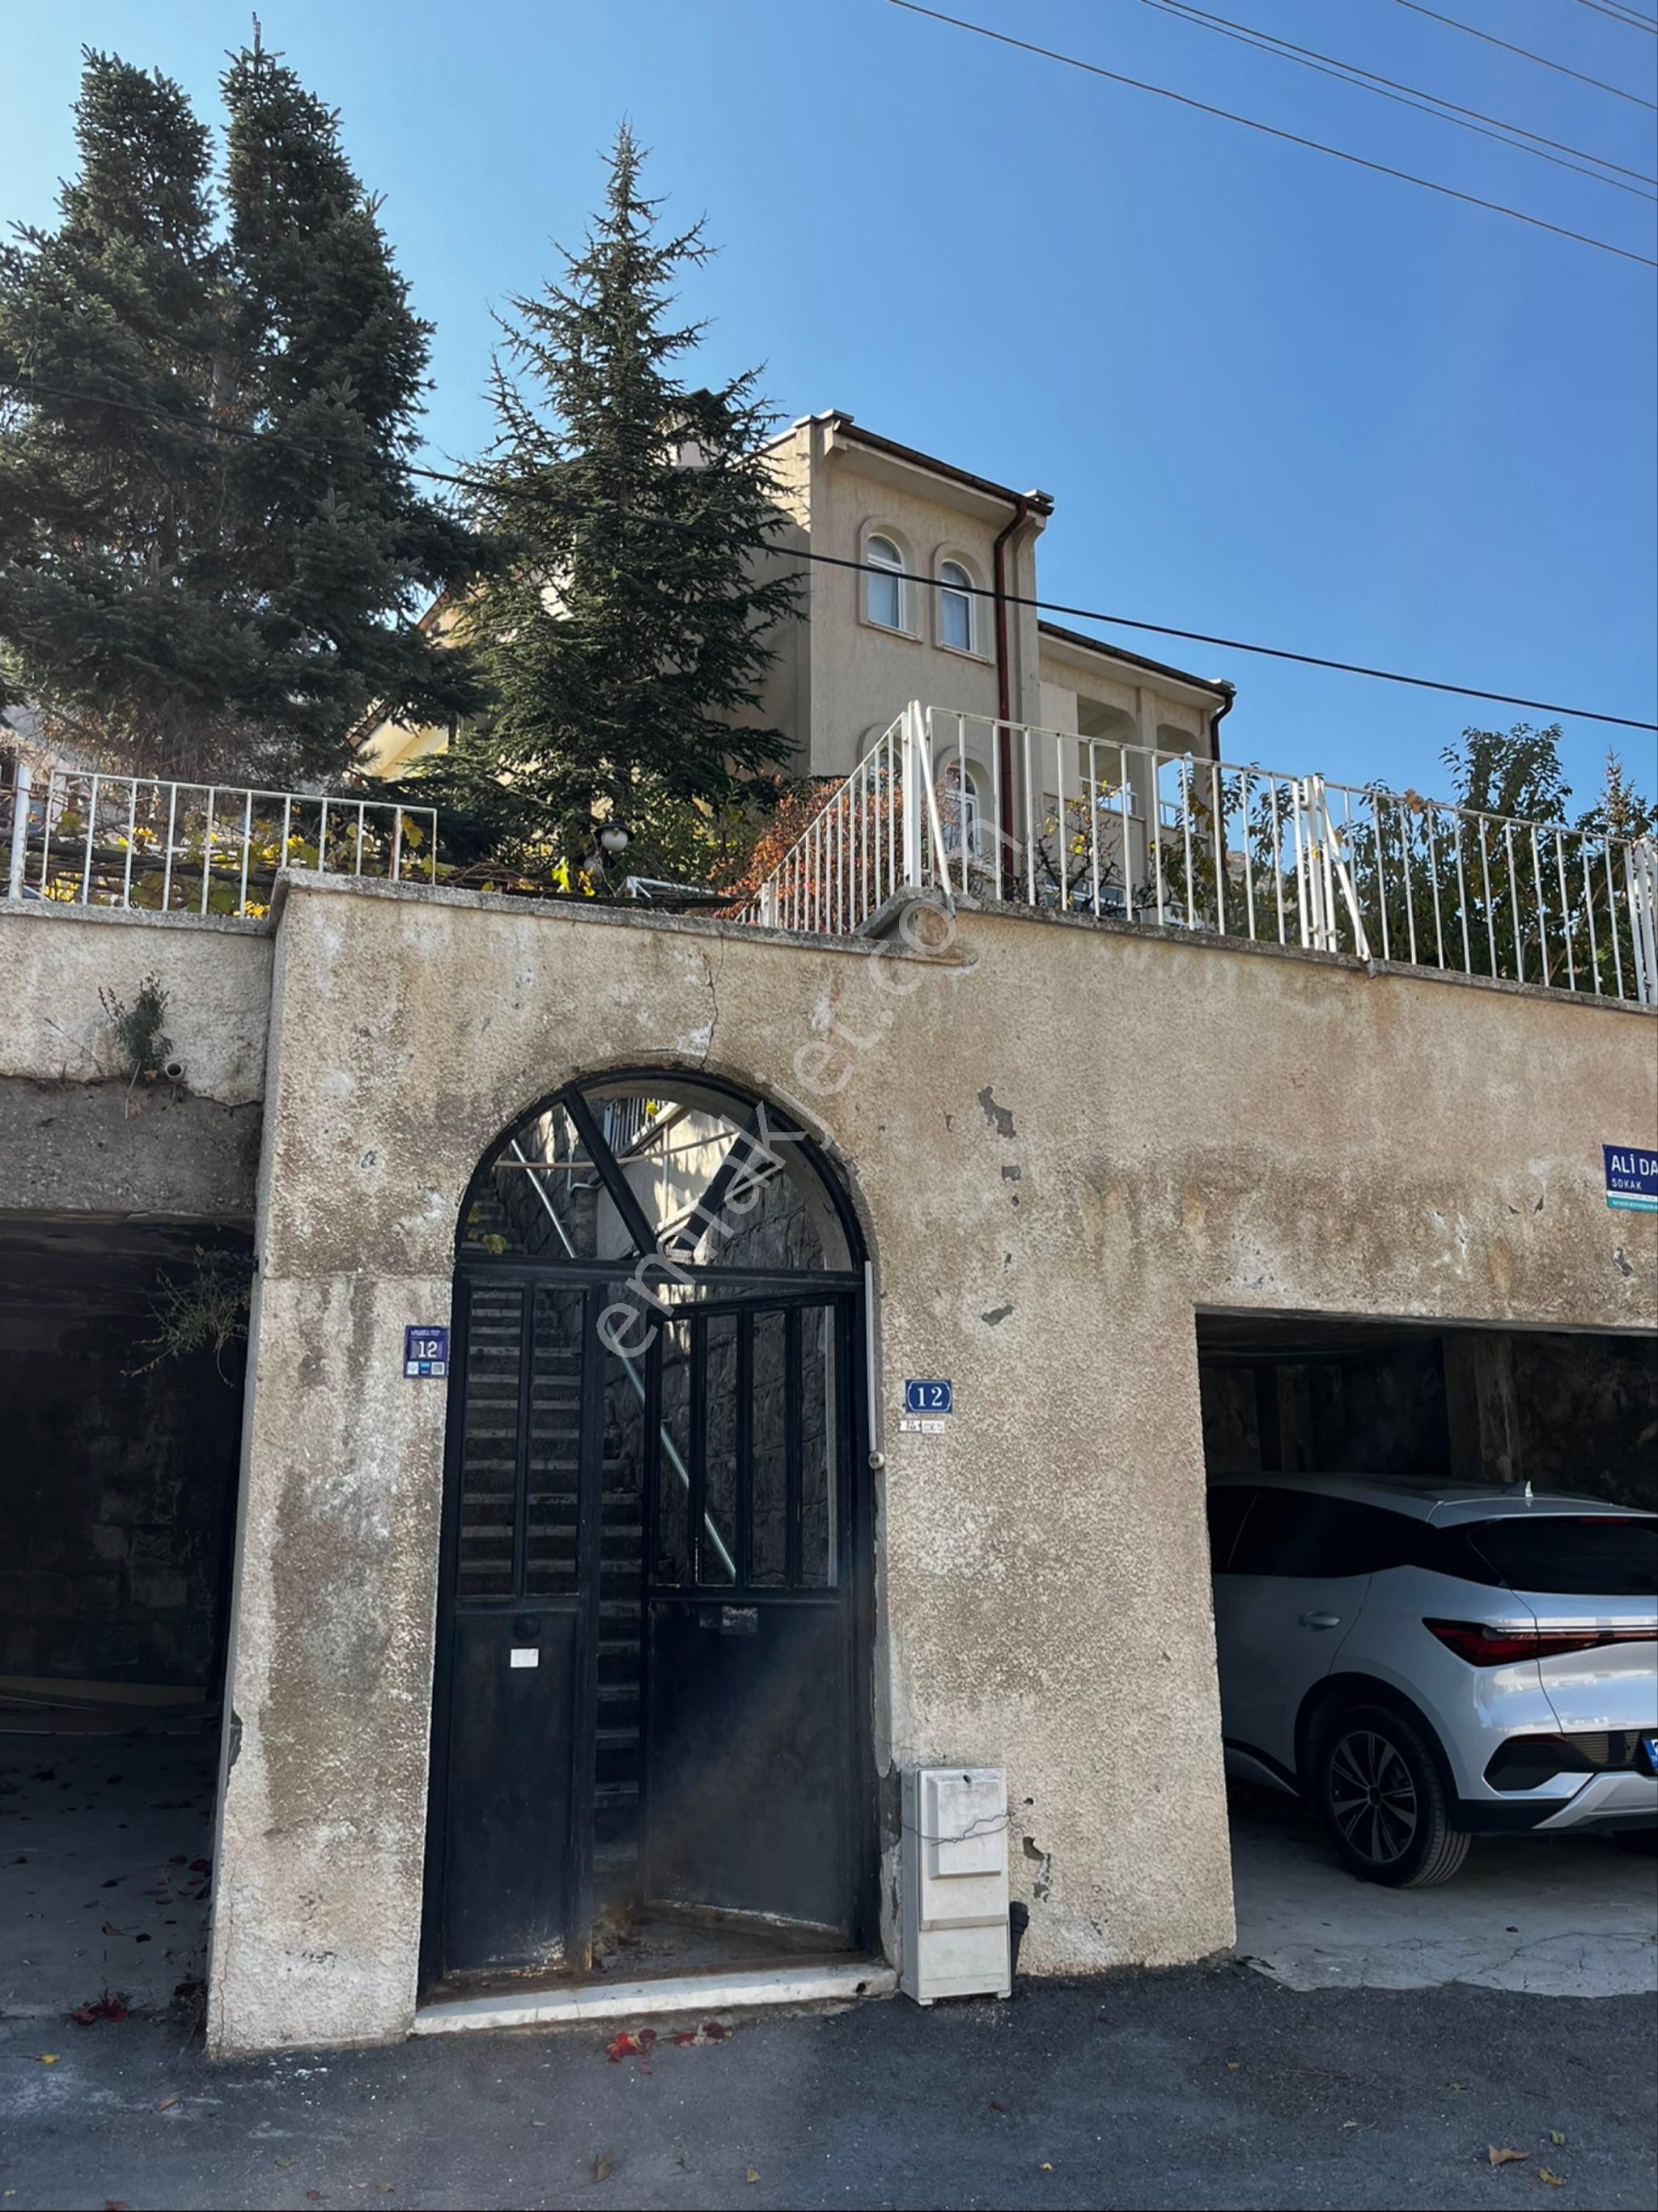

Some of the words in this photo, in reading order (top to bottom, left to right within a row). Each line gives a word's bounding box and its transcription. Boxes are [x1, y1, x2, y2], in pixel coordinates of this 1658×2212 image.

[1611, 1153, 1635, 1174] ALİ
[1611, 1178, 1642, 1191] SOKAK
[418, 1340, 438, 1358] 12
[918, 1386, 943, 1407] 12
